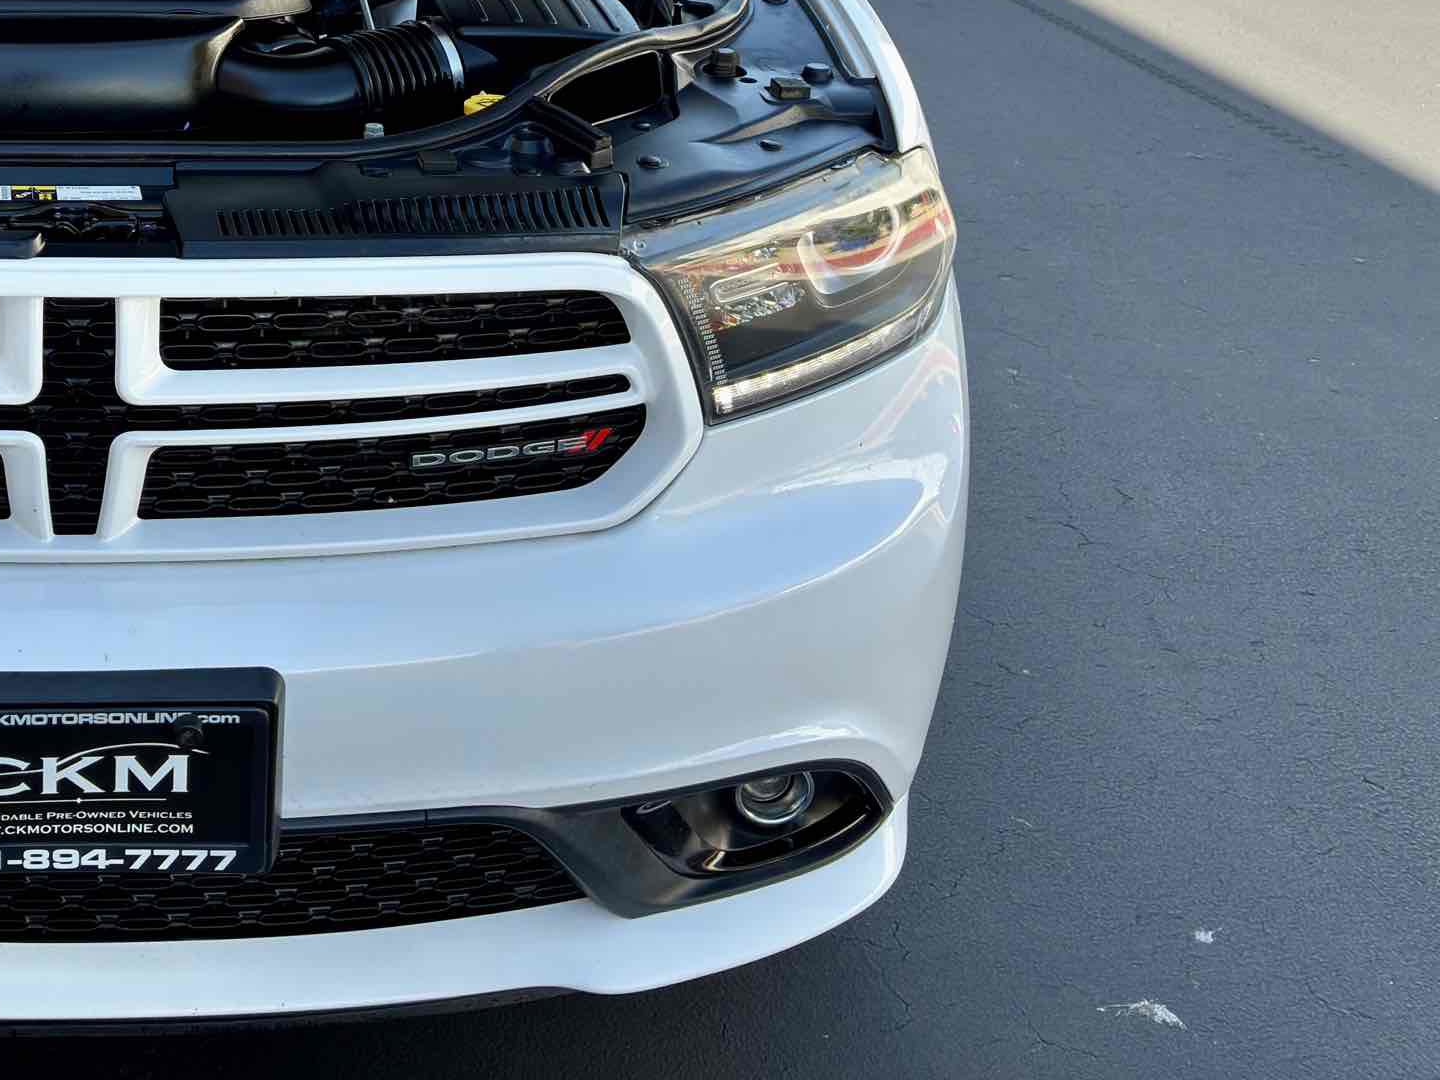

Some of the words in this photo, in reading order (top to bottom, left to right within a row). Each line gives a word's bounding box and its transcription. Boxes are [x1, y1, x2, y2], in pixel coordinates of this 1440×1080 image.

[412, 435, 589, 468] DODGE
[46, 810, 127, 821] PRE-OWNED
[128, 809, 193, 820] VEHICLES
